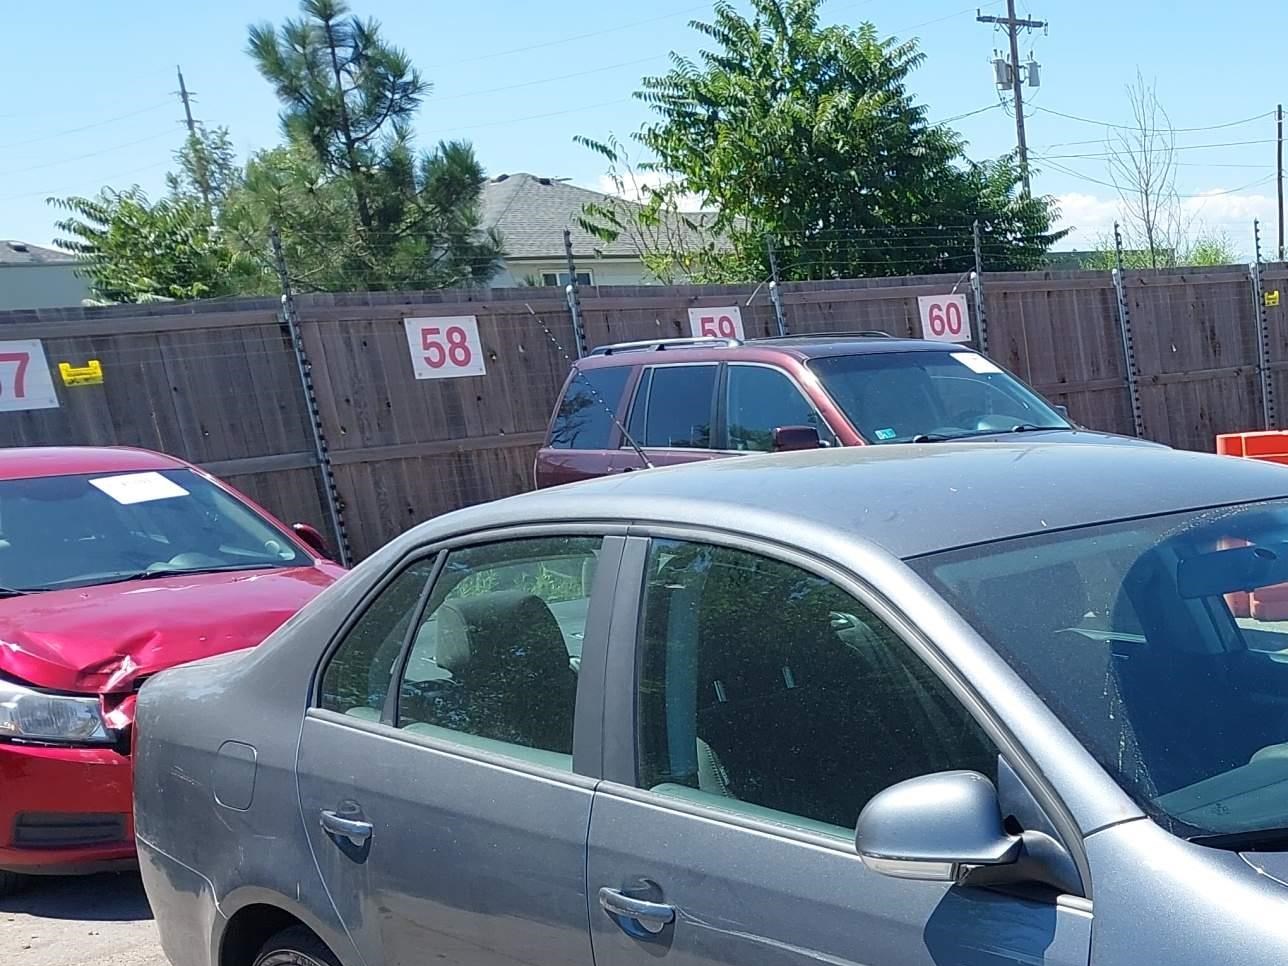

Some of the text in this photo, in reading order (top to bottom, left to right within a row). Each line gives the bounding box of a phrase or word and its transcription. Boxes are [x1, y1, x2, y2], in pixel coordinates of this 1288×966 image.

[929, 303, 961, 336] 60
[421, 326, 471, 368] 58
[0, 352, 30, 398] 7
